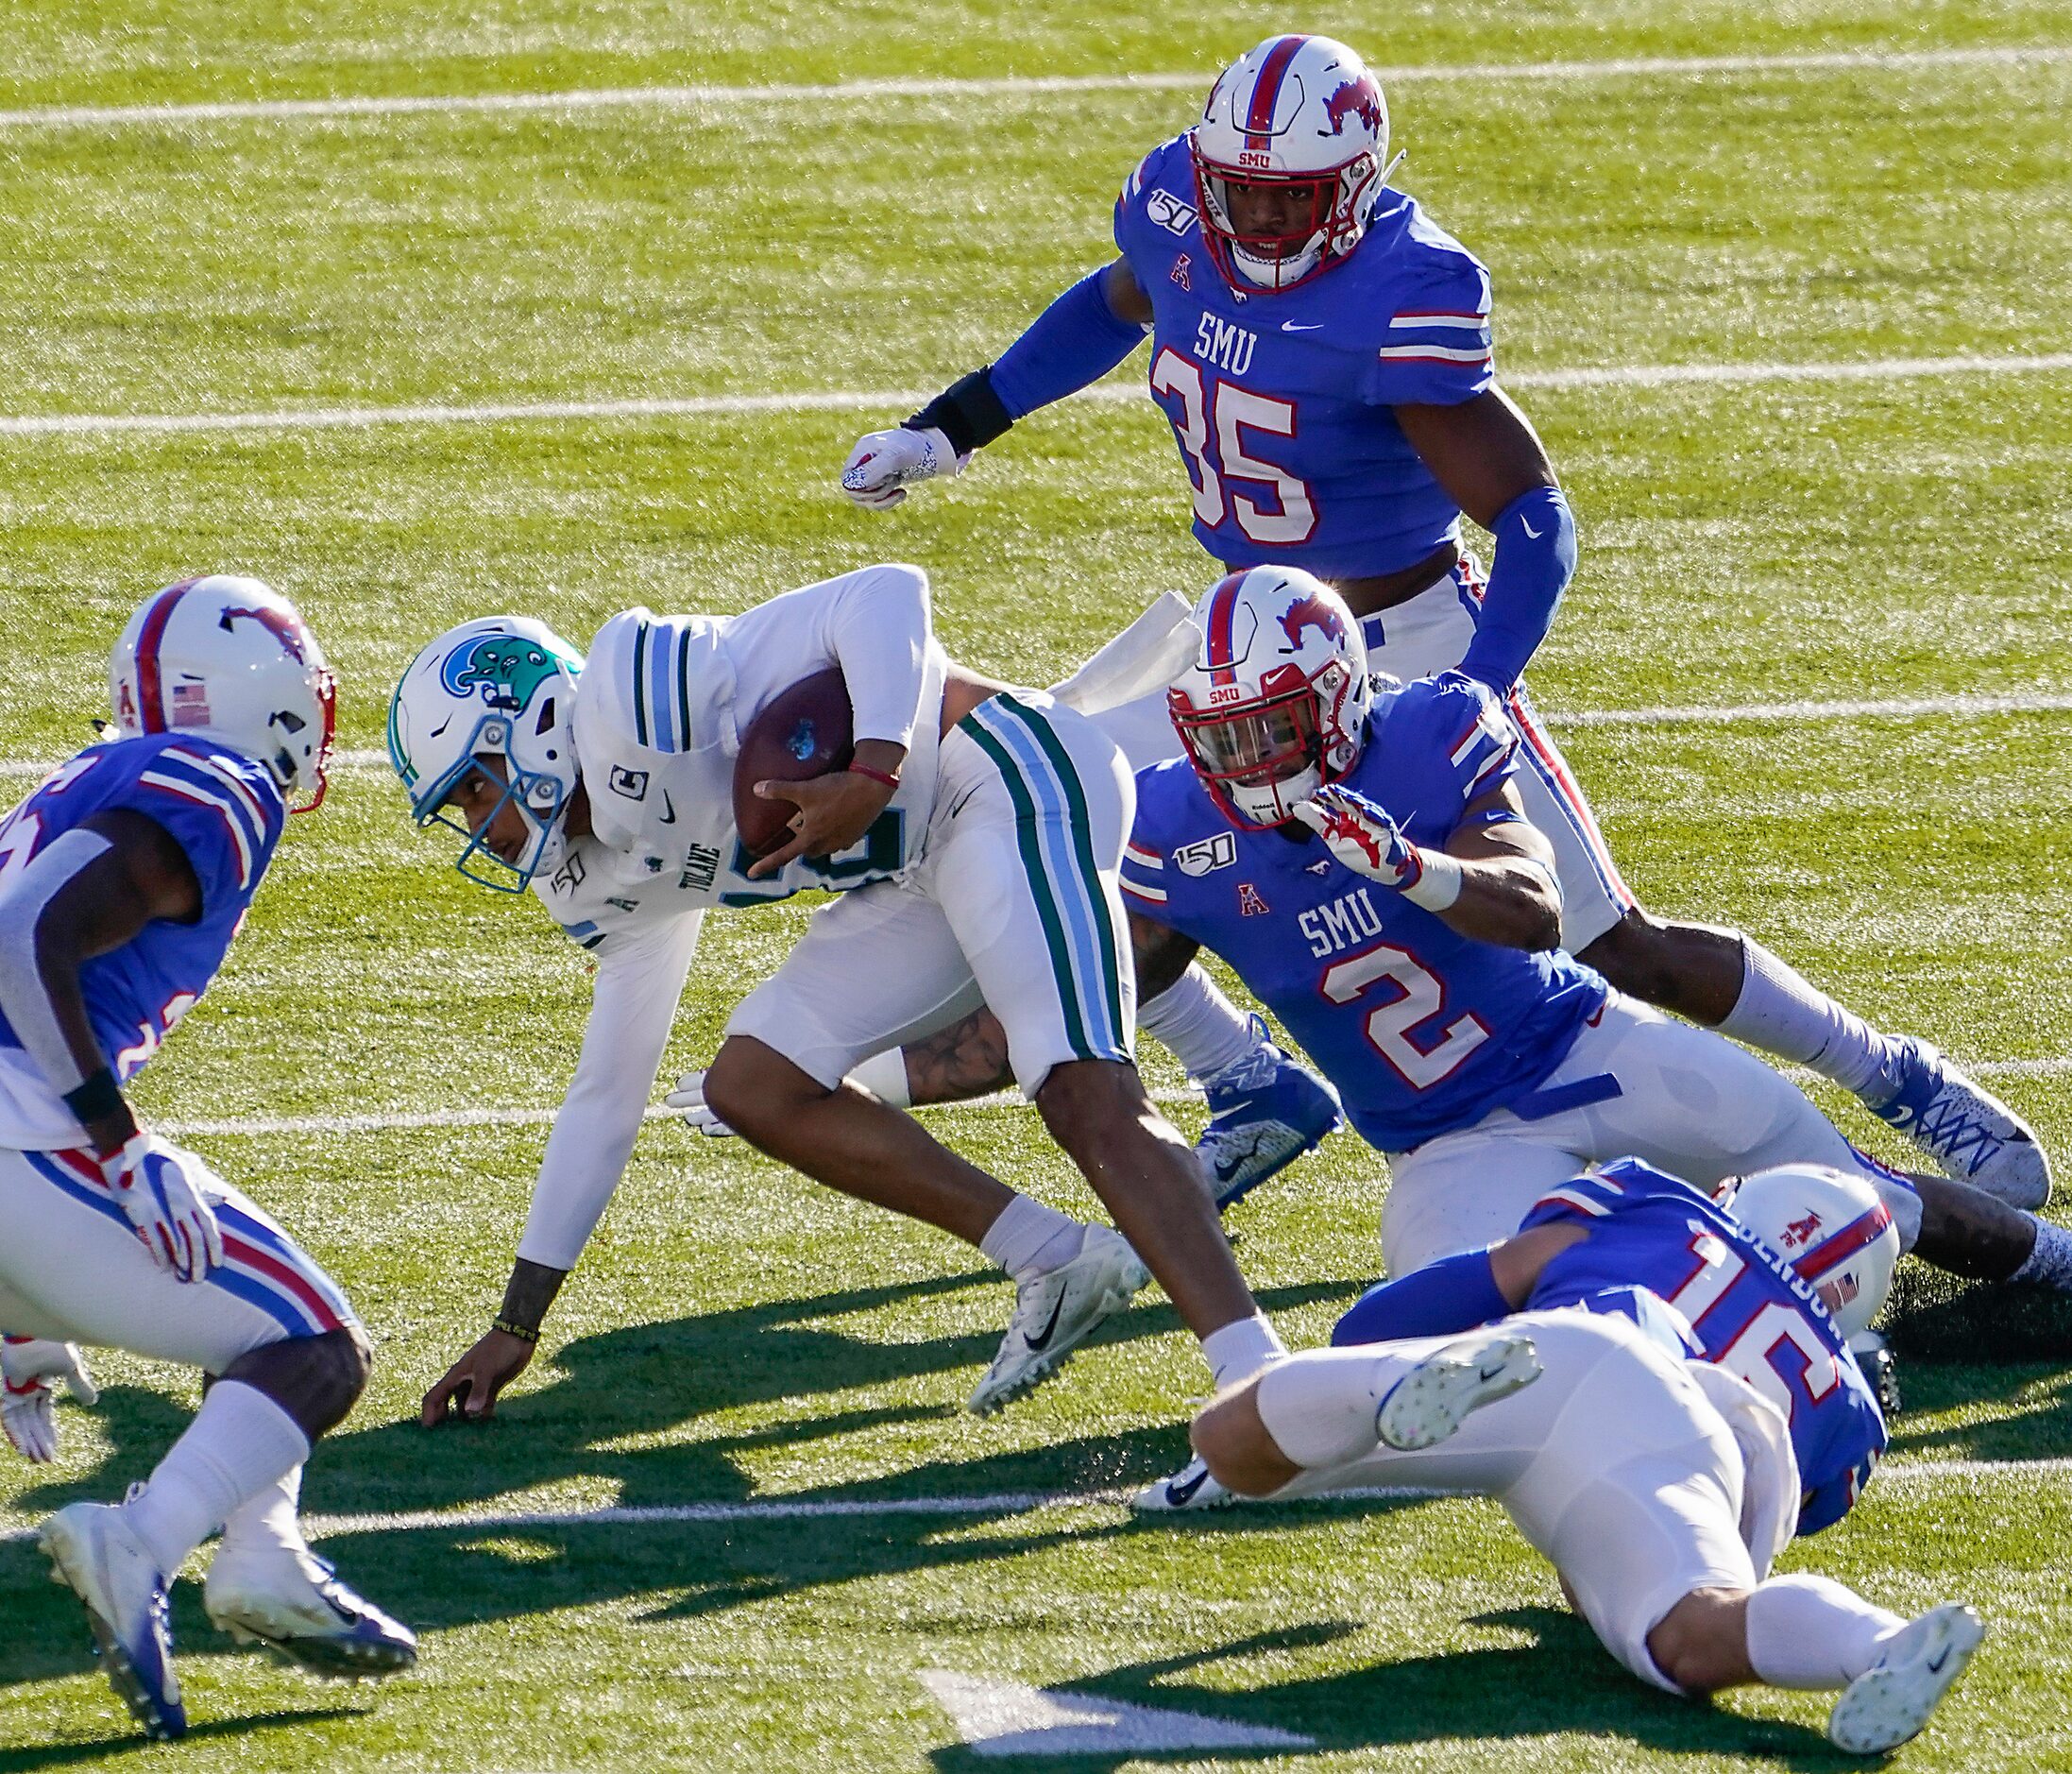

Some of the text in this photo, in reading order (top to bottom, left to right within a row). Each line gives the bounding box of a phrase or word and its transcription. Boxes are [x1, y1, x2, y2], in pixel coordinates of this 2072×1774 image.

[1239, 152, 1270, 168] SMU
[1148, 189, 1197, 235] 150
[1170, 253, 1191, 292] A
[1194, 311, 1257, 376] SMU
[1150, 346, 1317, 545] 35
[1210, 688, 1240, 705] SMU
[551, 851, 586, 896] 150
[678, 843, 721, 892] TULANE
[1173, 832, 1236, 876] 150
[1237, 884, 1269, 916] A
[1299, 888, 1384, 958] SMU
[1322, 946, 1489, 1090] 2
[1666, 1228, 1841, 1429] 16
